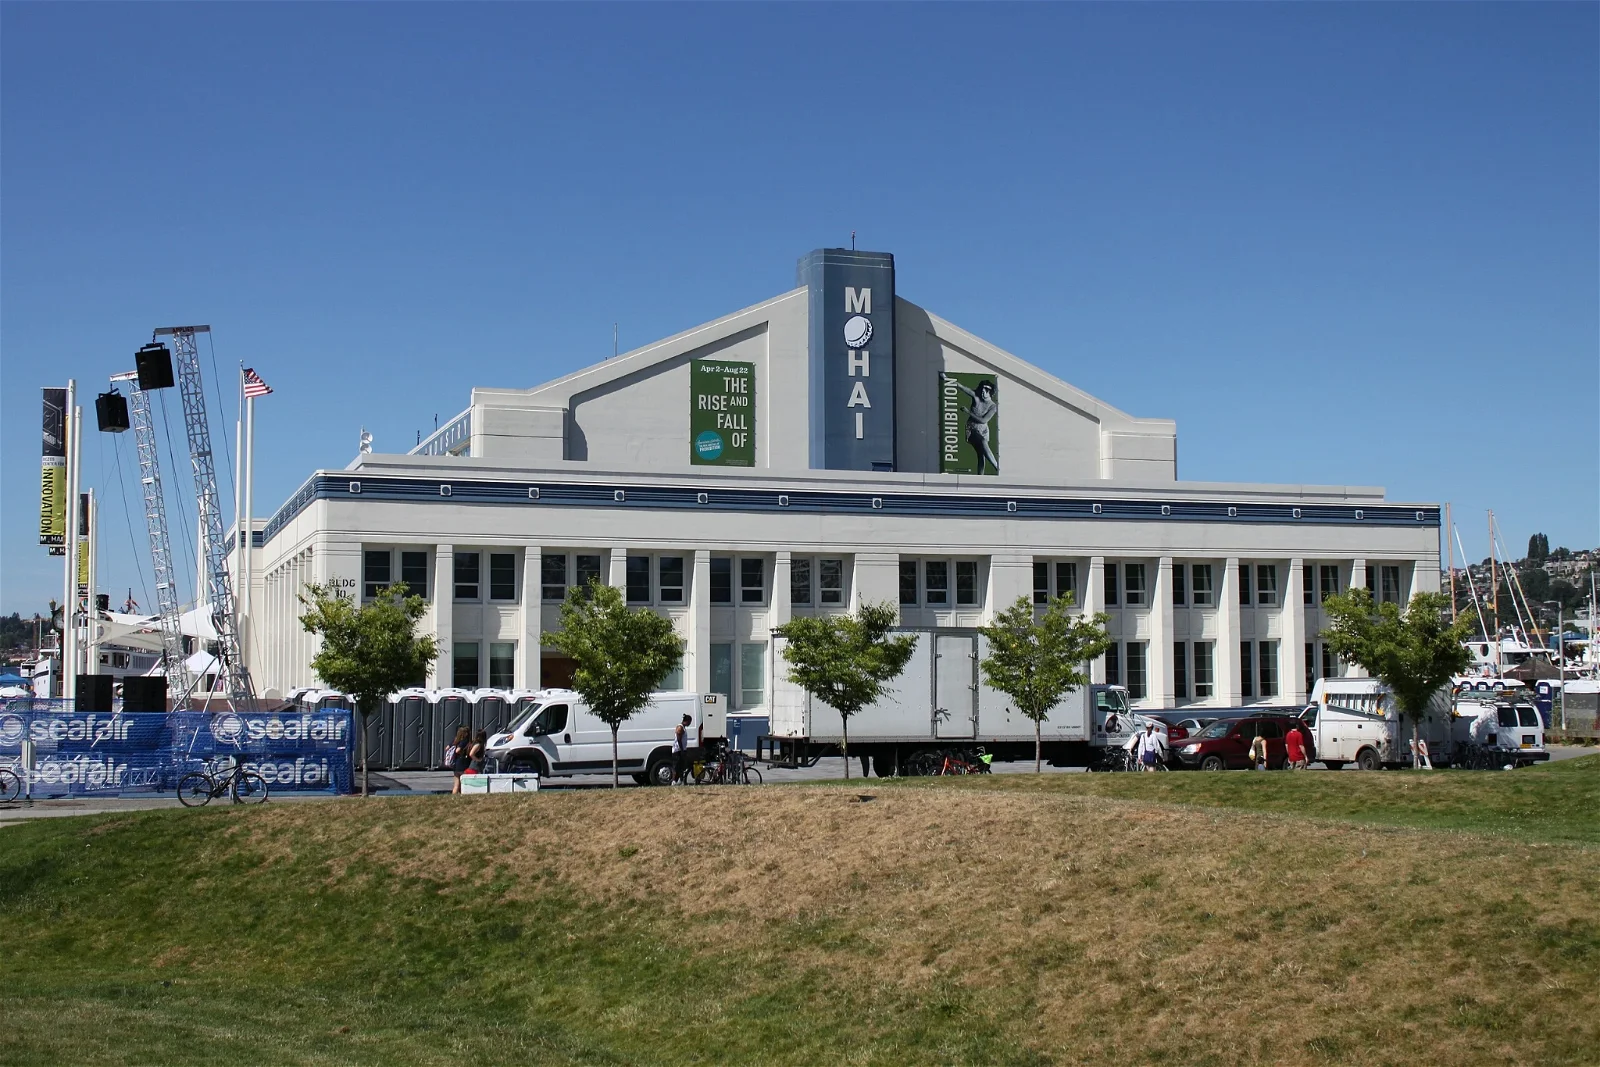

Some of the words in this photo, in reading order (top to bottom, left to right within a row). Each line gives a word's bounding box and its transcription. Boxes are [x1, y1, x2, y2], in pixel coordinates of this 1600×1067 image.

[700, 365, 715, 373] Apr
[723, 377, 748, 393] THE
[698, 394, 727, 411] RISE
[730, 396, 748, 407] AND
[717, 413, 748, 430] FALL
[944, 377, 958, 462] PROHIBITION
[732, 432, 748, 448] OF
[41, 468, 54, 534] INNOVATION
[328, 578, 356, 588] BLDG
[30, 714, 134, 741] seafair
[248, 714, 347, 740] seafair
[242, 757, 333, 784] seafai
